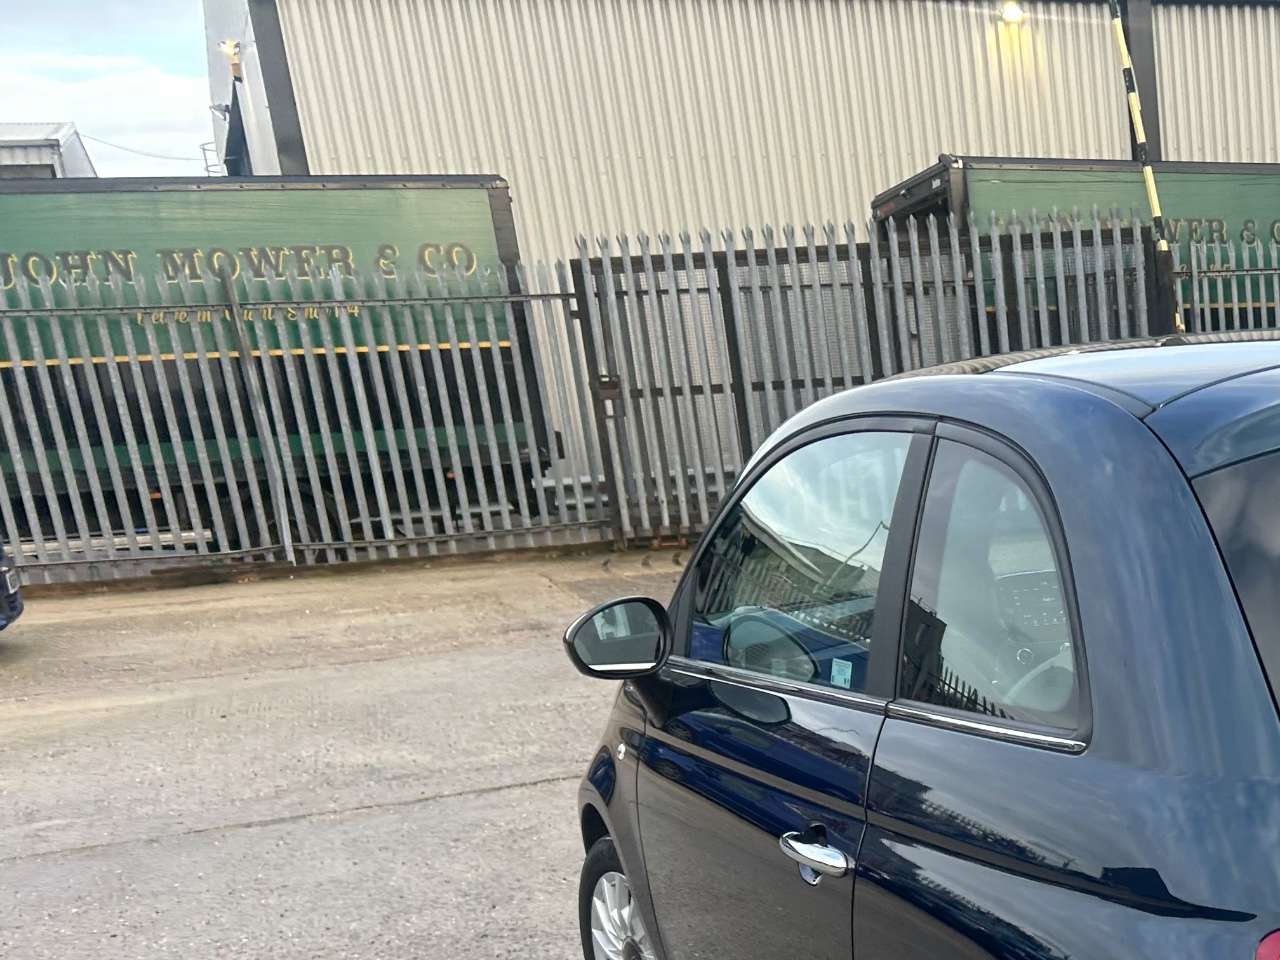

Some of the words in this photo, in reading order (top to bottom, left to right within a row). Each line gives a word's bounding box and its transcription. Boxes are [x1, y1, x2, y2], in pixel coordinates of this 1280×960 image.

[1240, 219, 1258, 248] &
[0, 249, 138, 290] JOHN
[156, 244, 356, 284] MOWER
[375, 243, 400, 279] &
